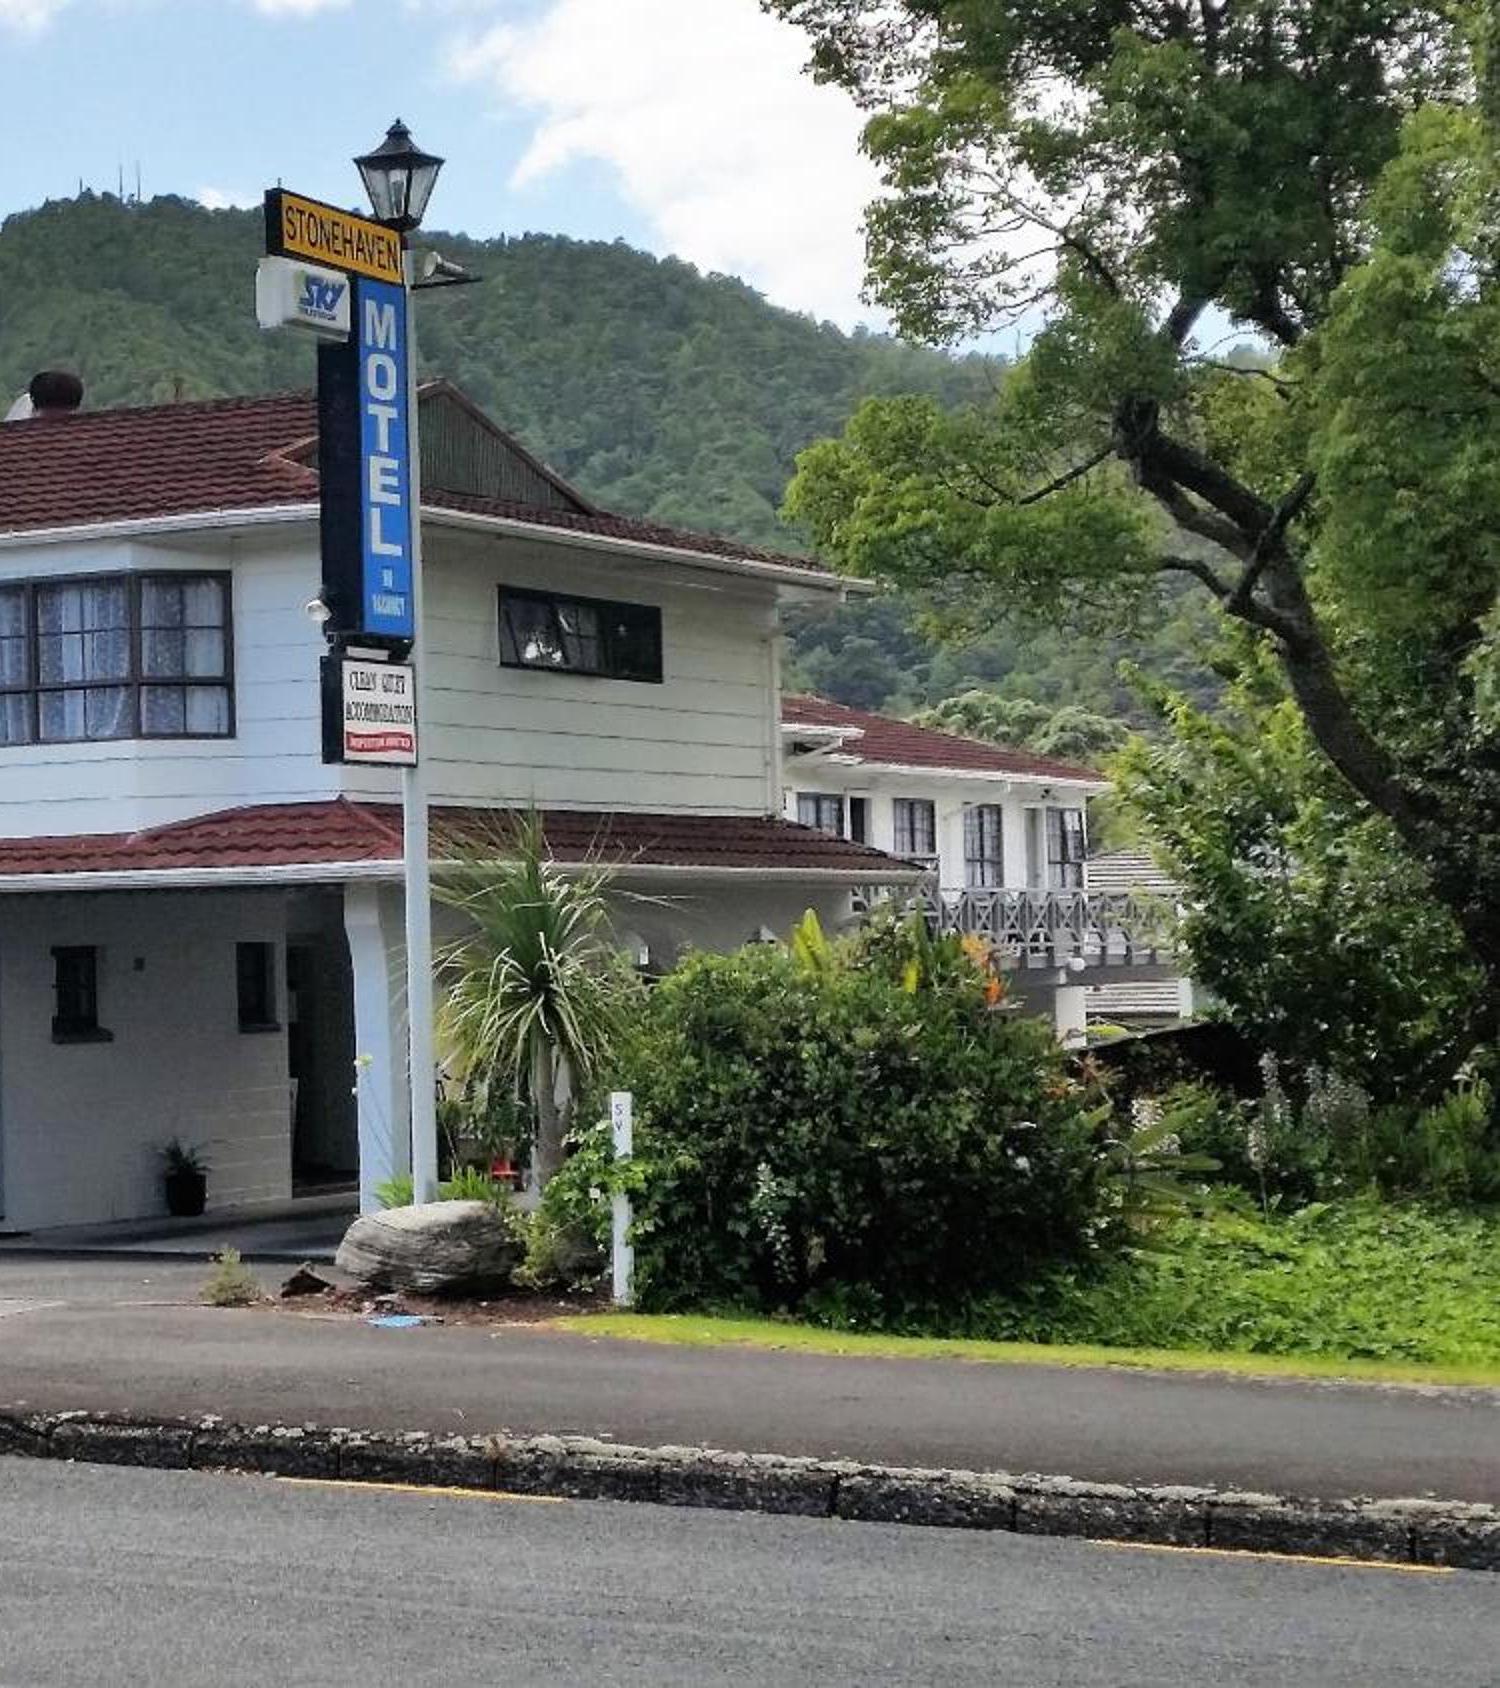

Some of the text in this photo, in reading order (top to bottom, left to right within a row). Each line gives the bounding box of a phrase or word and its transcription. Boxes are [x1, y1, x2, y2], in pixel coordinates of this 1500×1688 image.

[284, 205, 399, 273] STONEHAVEN
[299, 275, 346, 312] SKY
[364, 299, 403, 557] MOTEL
